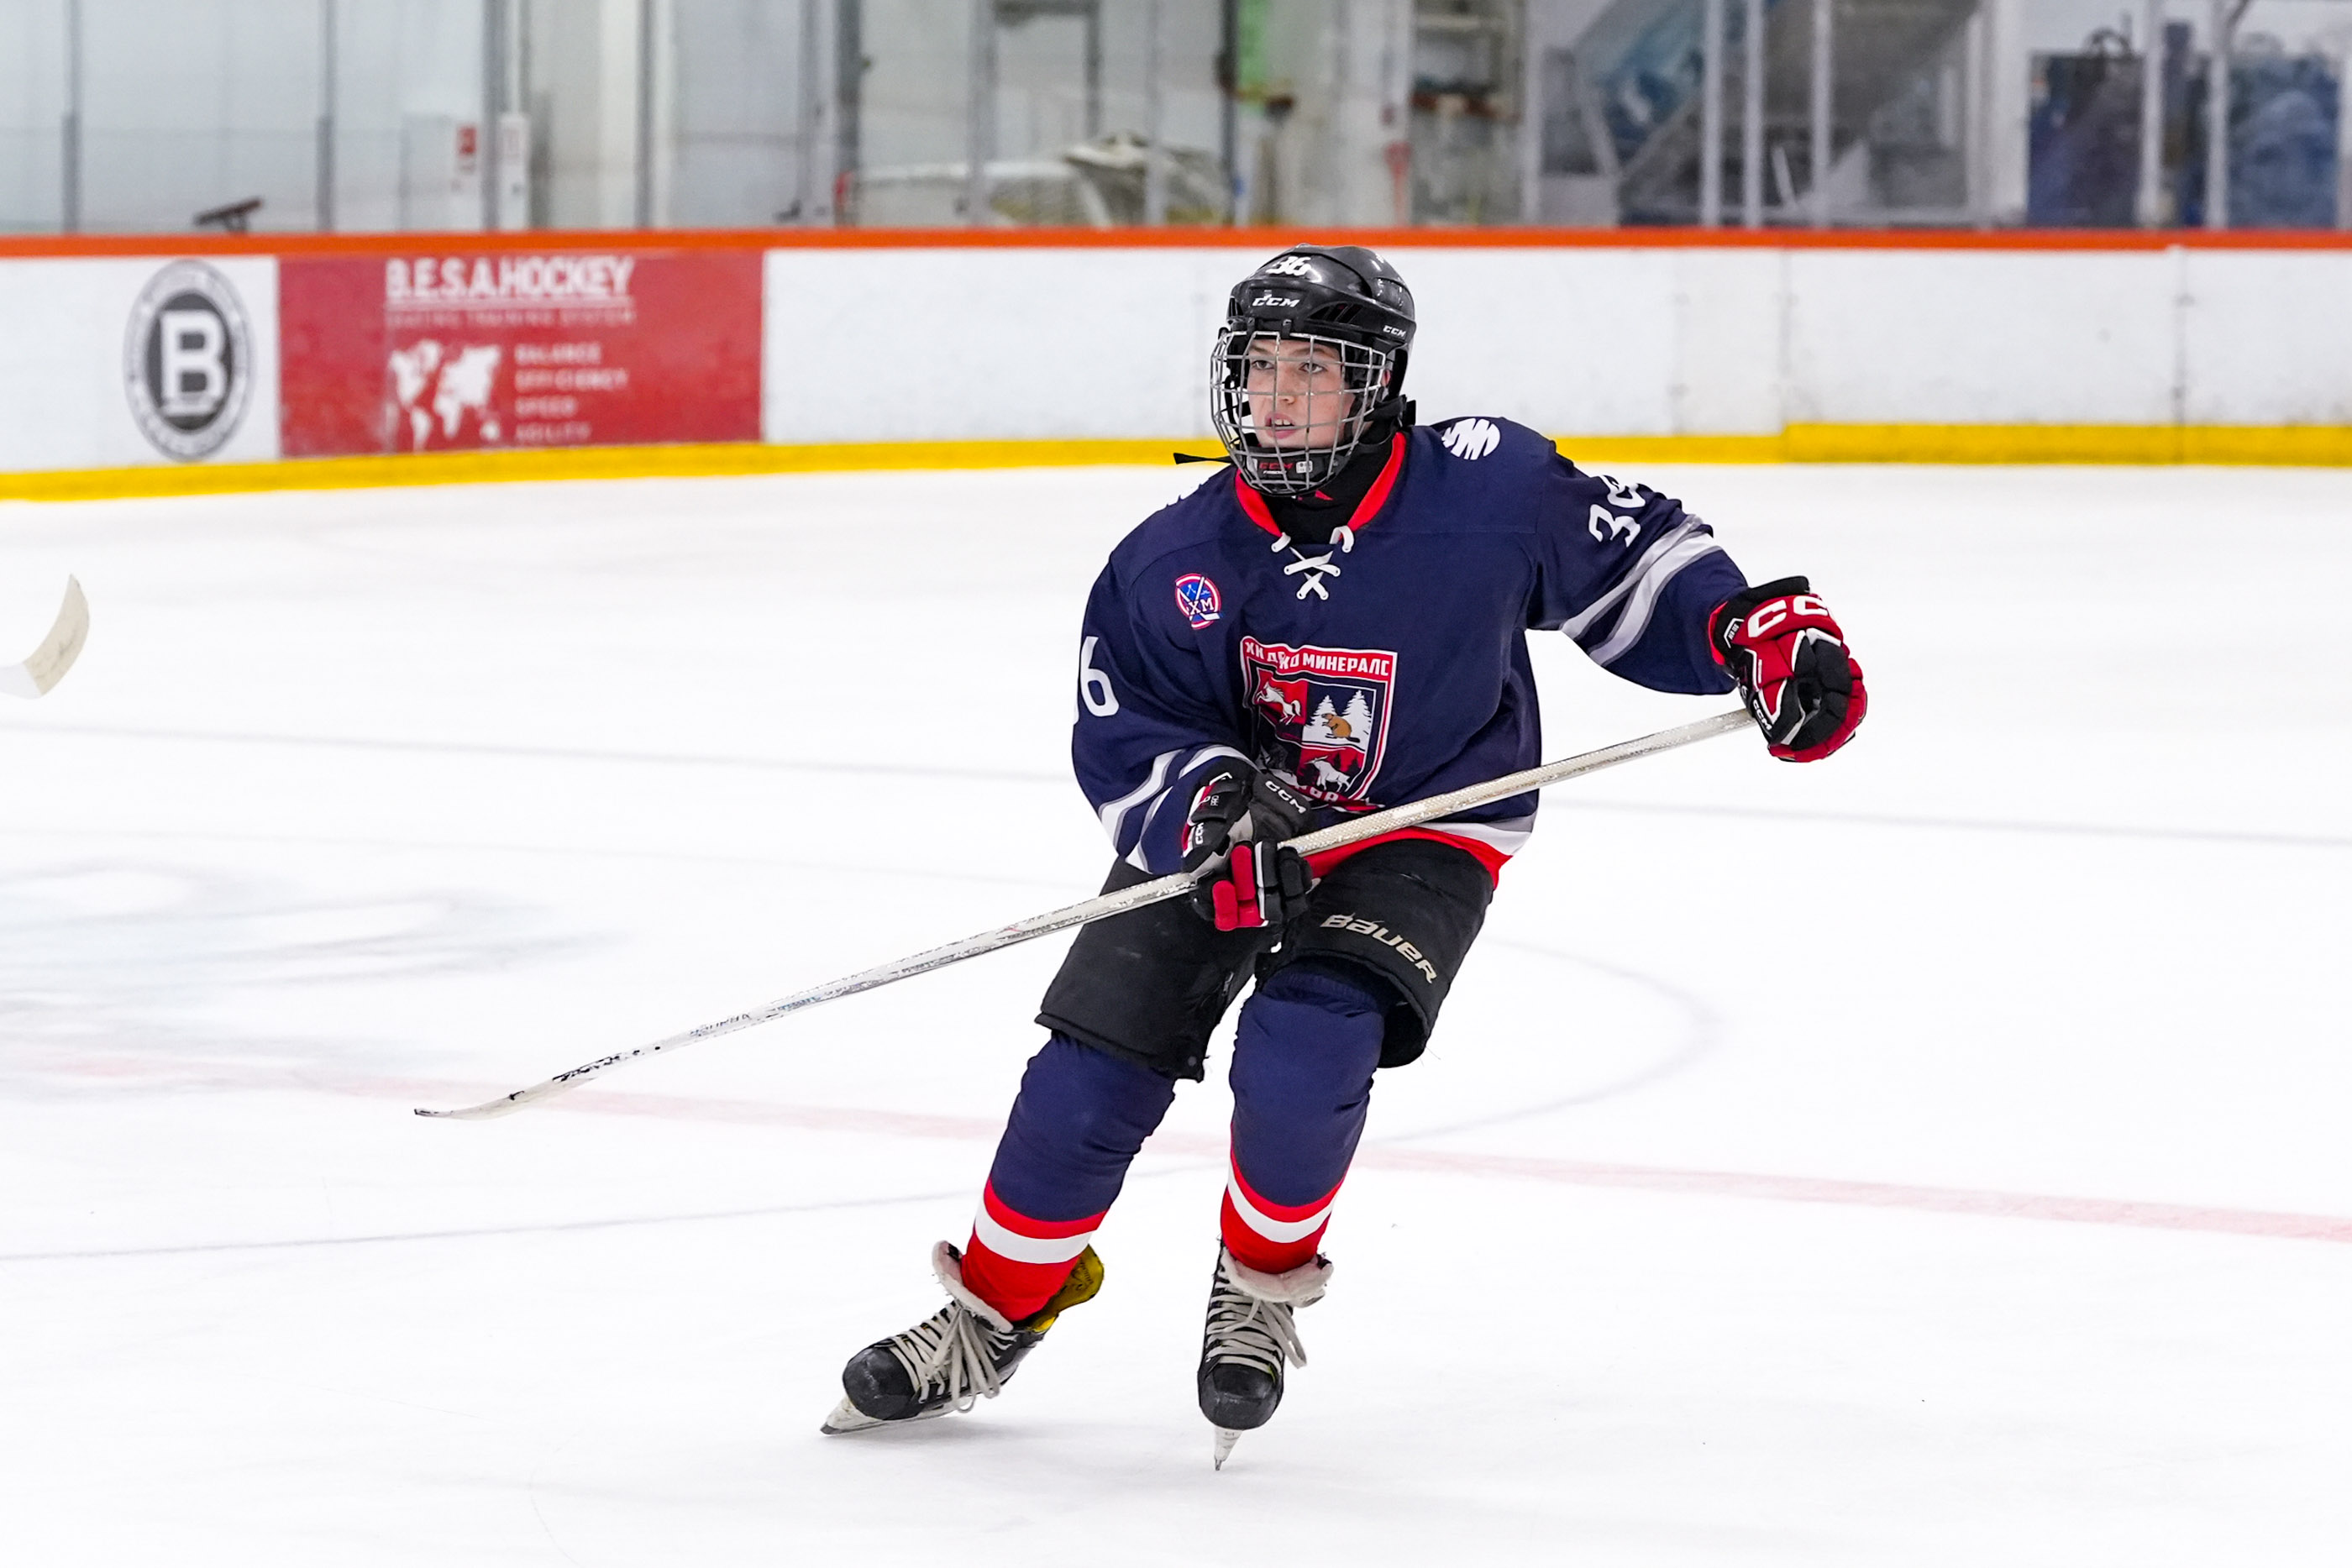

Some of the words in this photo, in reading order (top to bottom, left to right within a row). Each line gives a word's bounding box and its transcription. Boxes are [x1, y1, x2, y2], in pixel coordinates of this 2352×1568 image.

[1252, 296, 1300, 307] CCM
[1383, 324, 1407, 337] CCM
[161, 310, 226, 416] B
[1748, 595, 1831, 638] CC
[1303, 653, 1390, 676] МИНЕРАЛС
[1753, 699, 1772, 731] CCM
[1265, 780, 1307, 814] CCM
